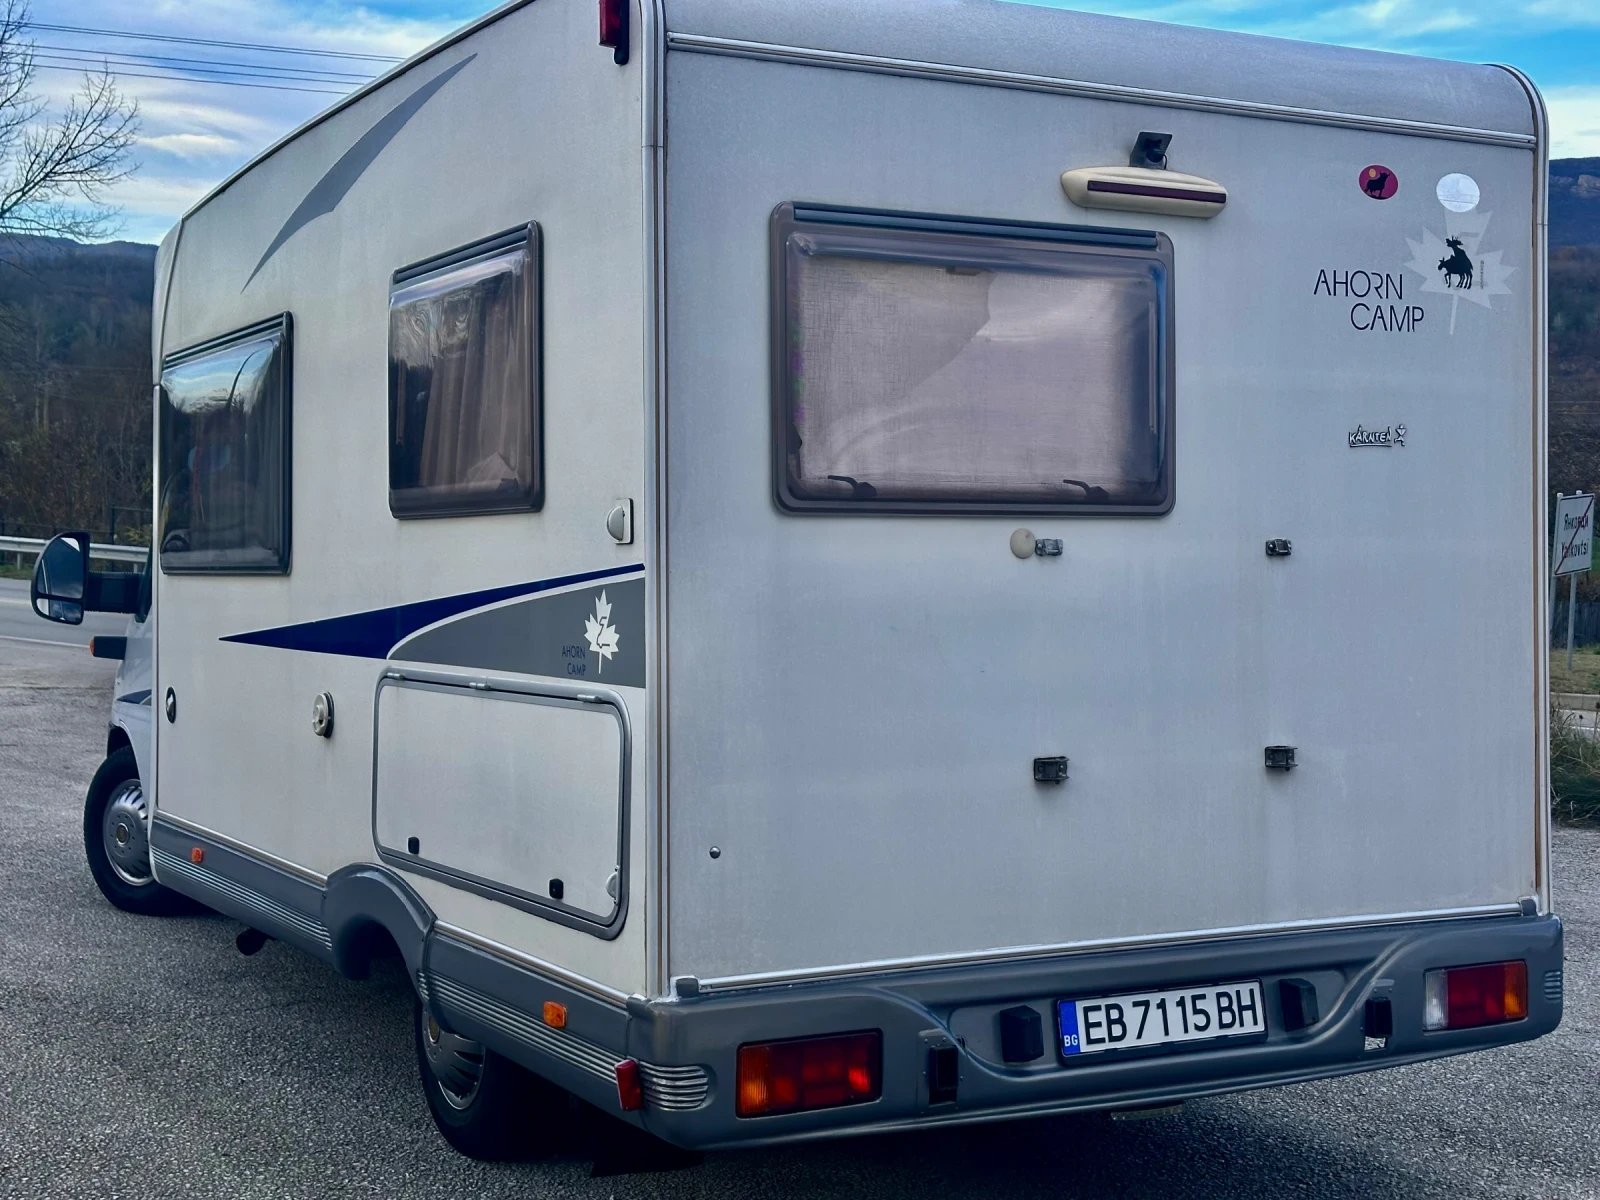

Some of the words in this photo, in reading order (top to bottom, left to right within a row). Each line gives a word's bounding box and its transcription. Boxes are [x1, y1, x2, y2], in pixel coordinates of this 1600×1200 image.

[1313, 269, 1403, 300] AHORN
[1350, 302, 1425, 333] CAMP
[562, 645, 586, 659] AHORN
[567, 662, 586, 676] CAMP
[1063, 1034, 1079, 1047] BG
